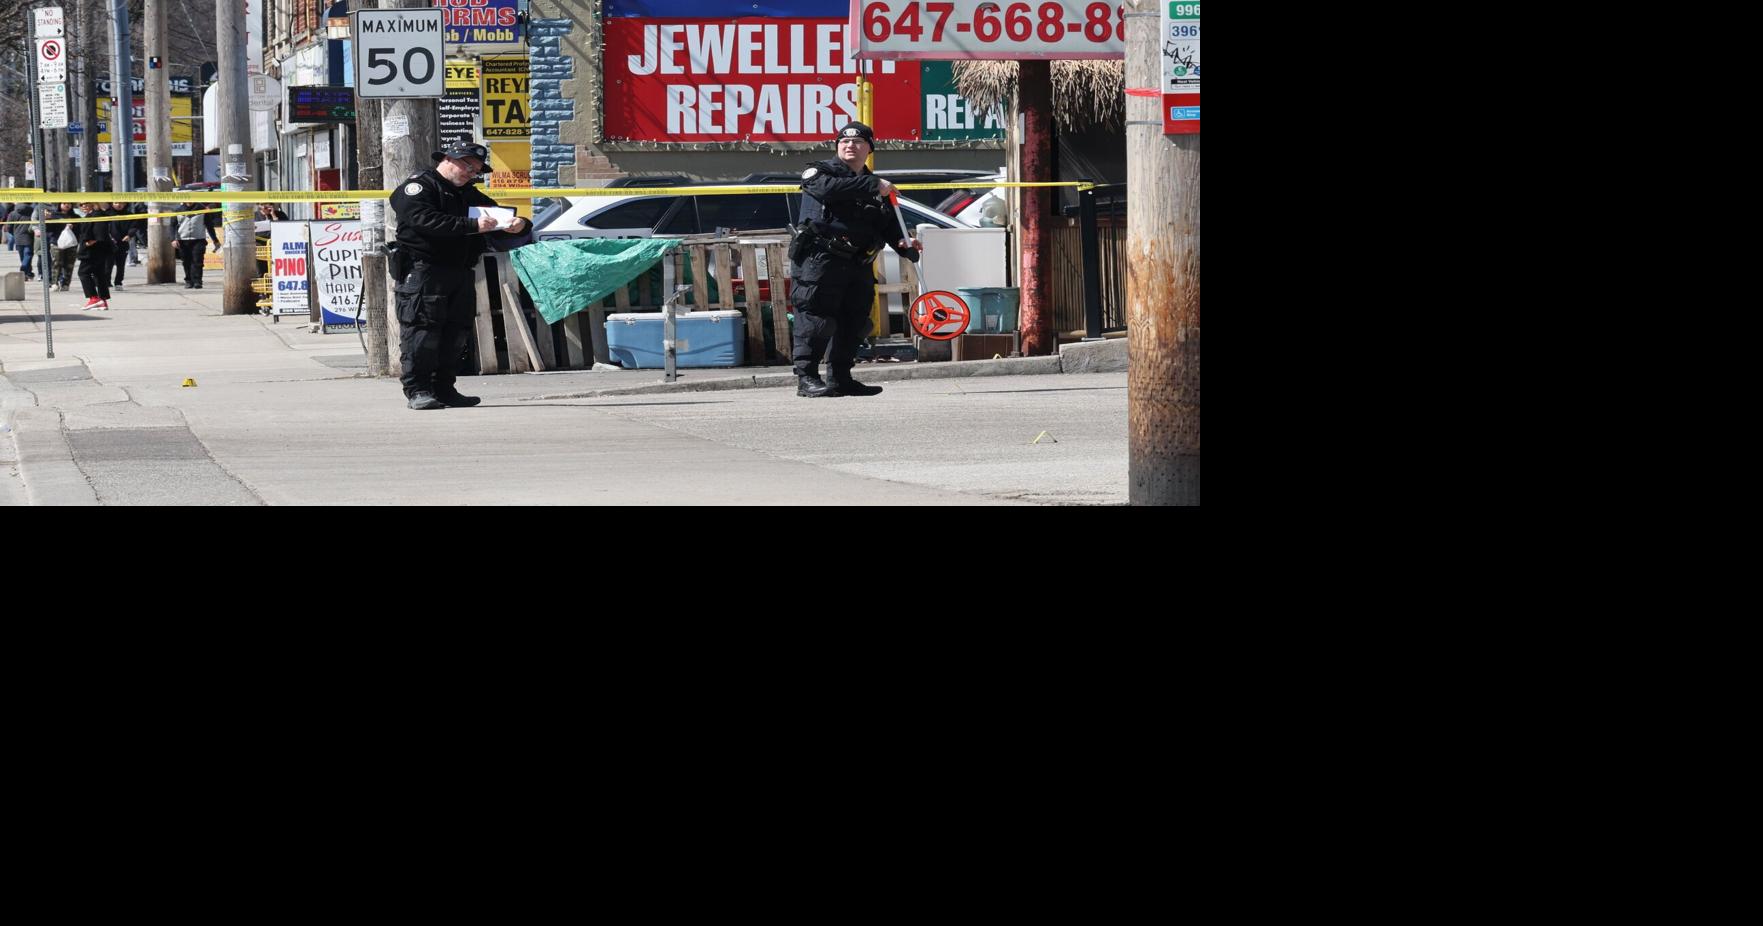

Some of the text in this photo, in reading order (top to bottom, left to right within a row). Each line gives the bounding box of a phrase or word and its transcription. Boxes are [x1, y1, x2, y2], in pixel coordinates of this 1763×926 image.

[1176, 4, 1200, 16] 996
[37, 18, 62, 26] STANDING
[362, 19, 438, 33] MAXIMUM
[473, 29, 514, 41] Mobb
[1172, 25, 1200, 37] 396
[628, 24, 896, 75] JEWELLE
[367, 46, 435, 86] 50
[486, 99, 531, 123] TA
[666, 83, 858, 134] REPAIRS
[274, 257, 306, 277] PINO
[325, 282, 355, 294] HAIR
